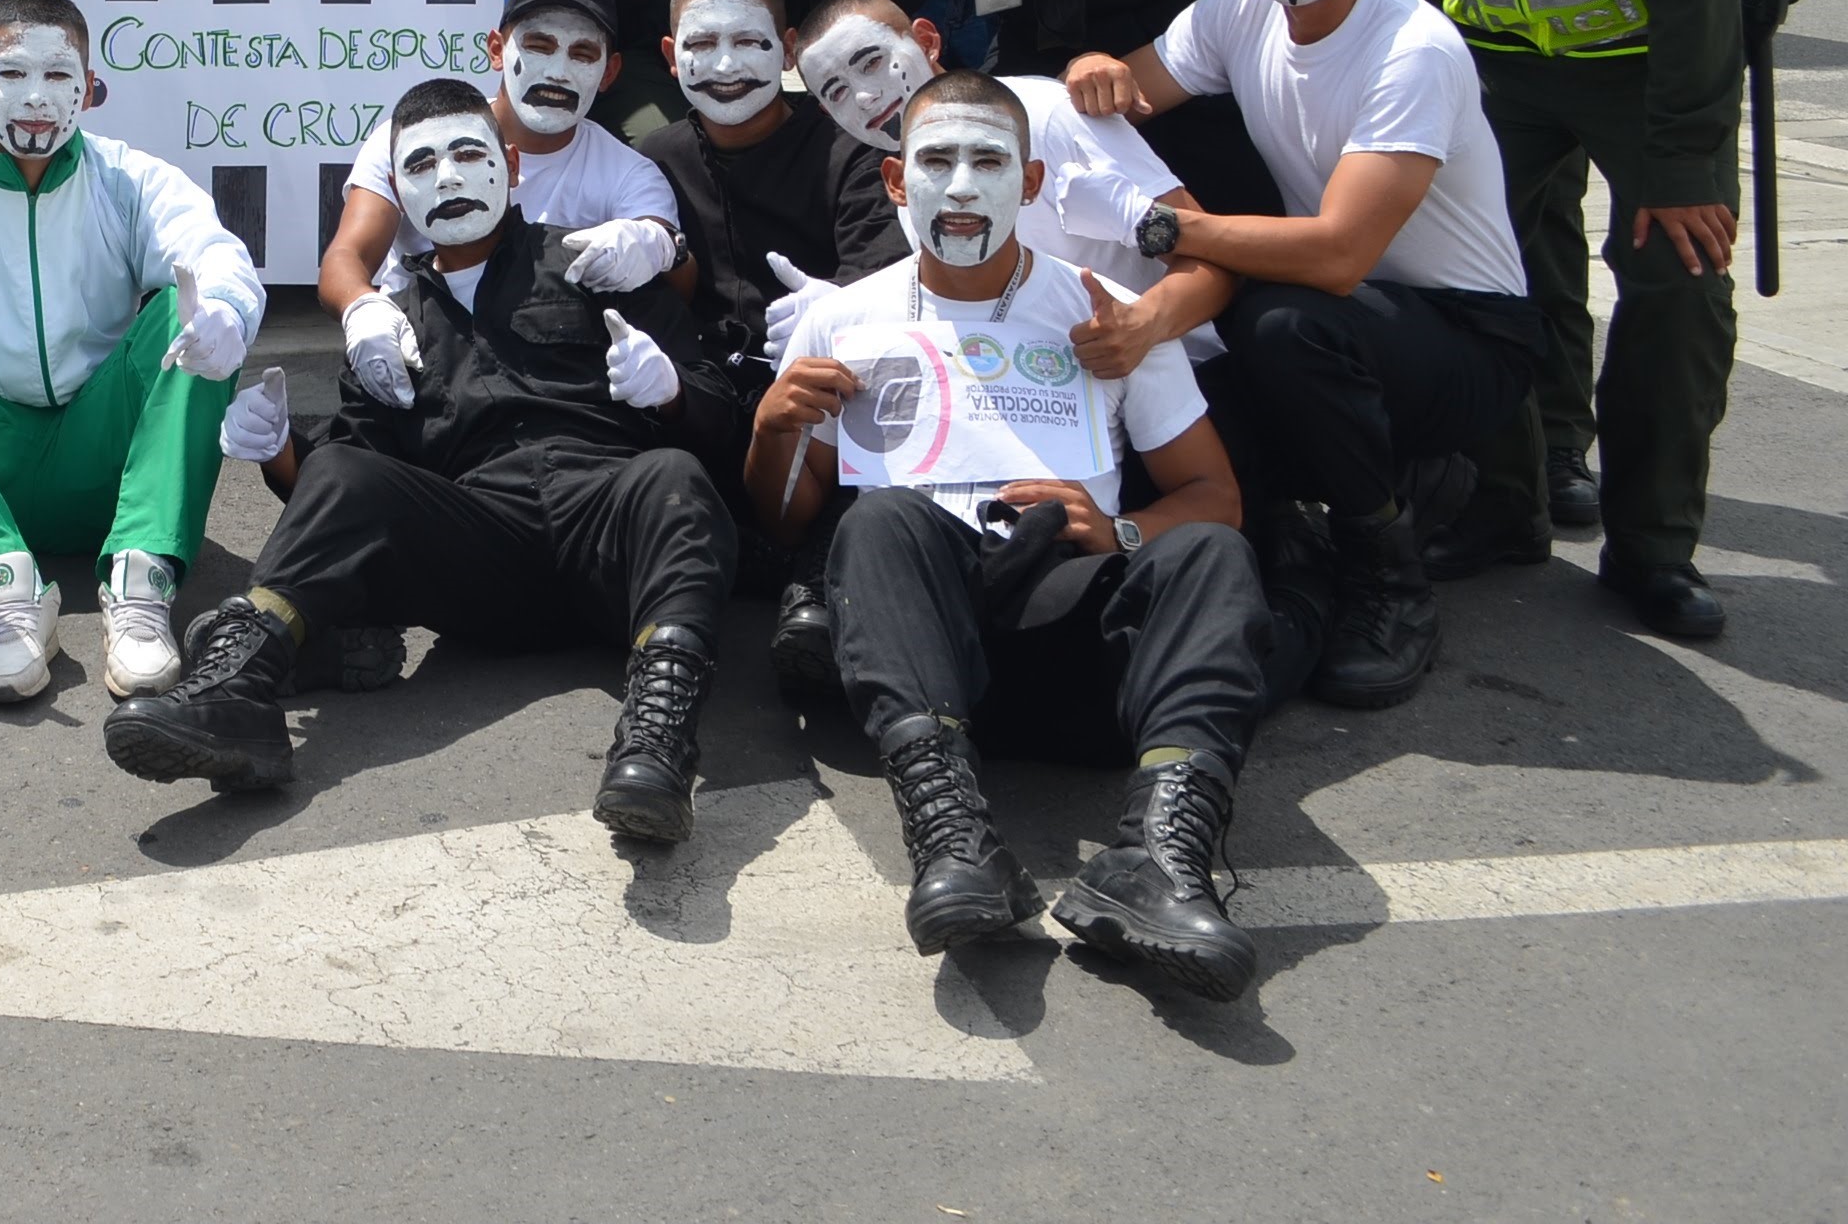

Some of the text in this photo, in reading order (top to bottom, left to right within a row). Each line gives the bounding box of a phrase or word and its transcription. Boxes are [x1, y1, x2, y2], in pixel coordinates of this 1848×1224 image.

[100, 16, 492, 75] CONTESTA DESPUES
[185, 100, 248, 150] DE
[965, 384, 1077, 401] UTILICE SU CASCO PROTECTOR
[967, 394, 1077, 418] MOTOCICLETA,
[968, 412, 1079, 428] AL CONDUCIR O MONTAR
